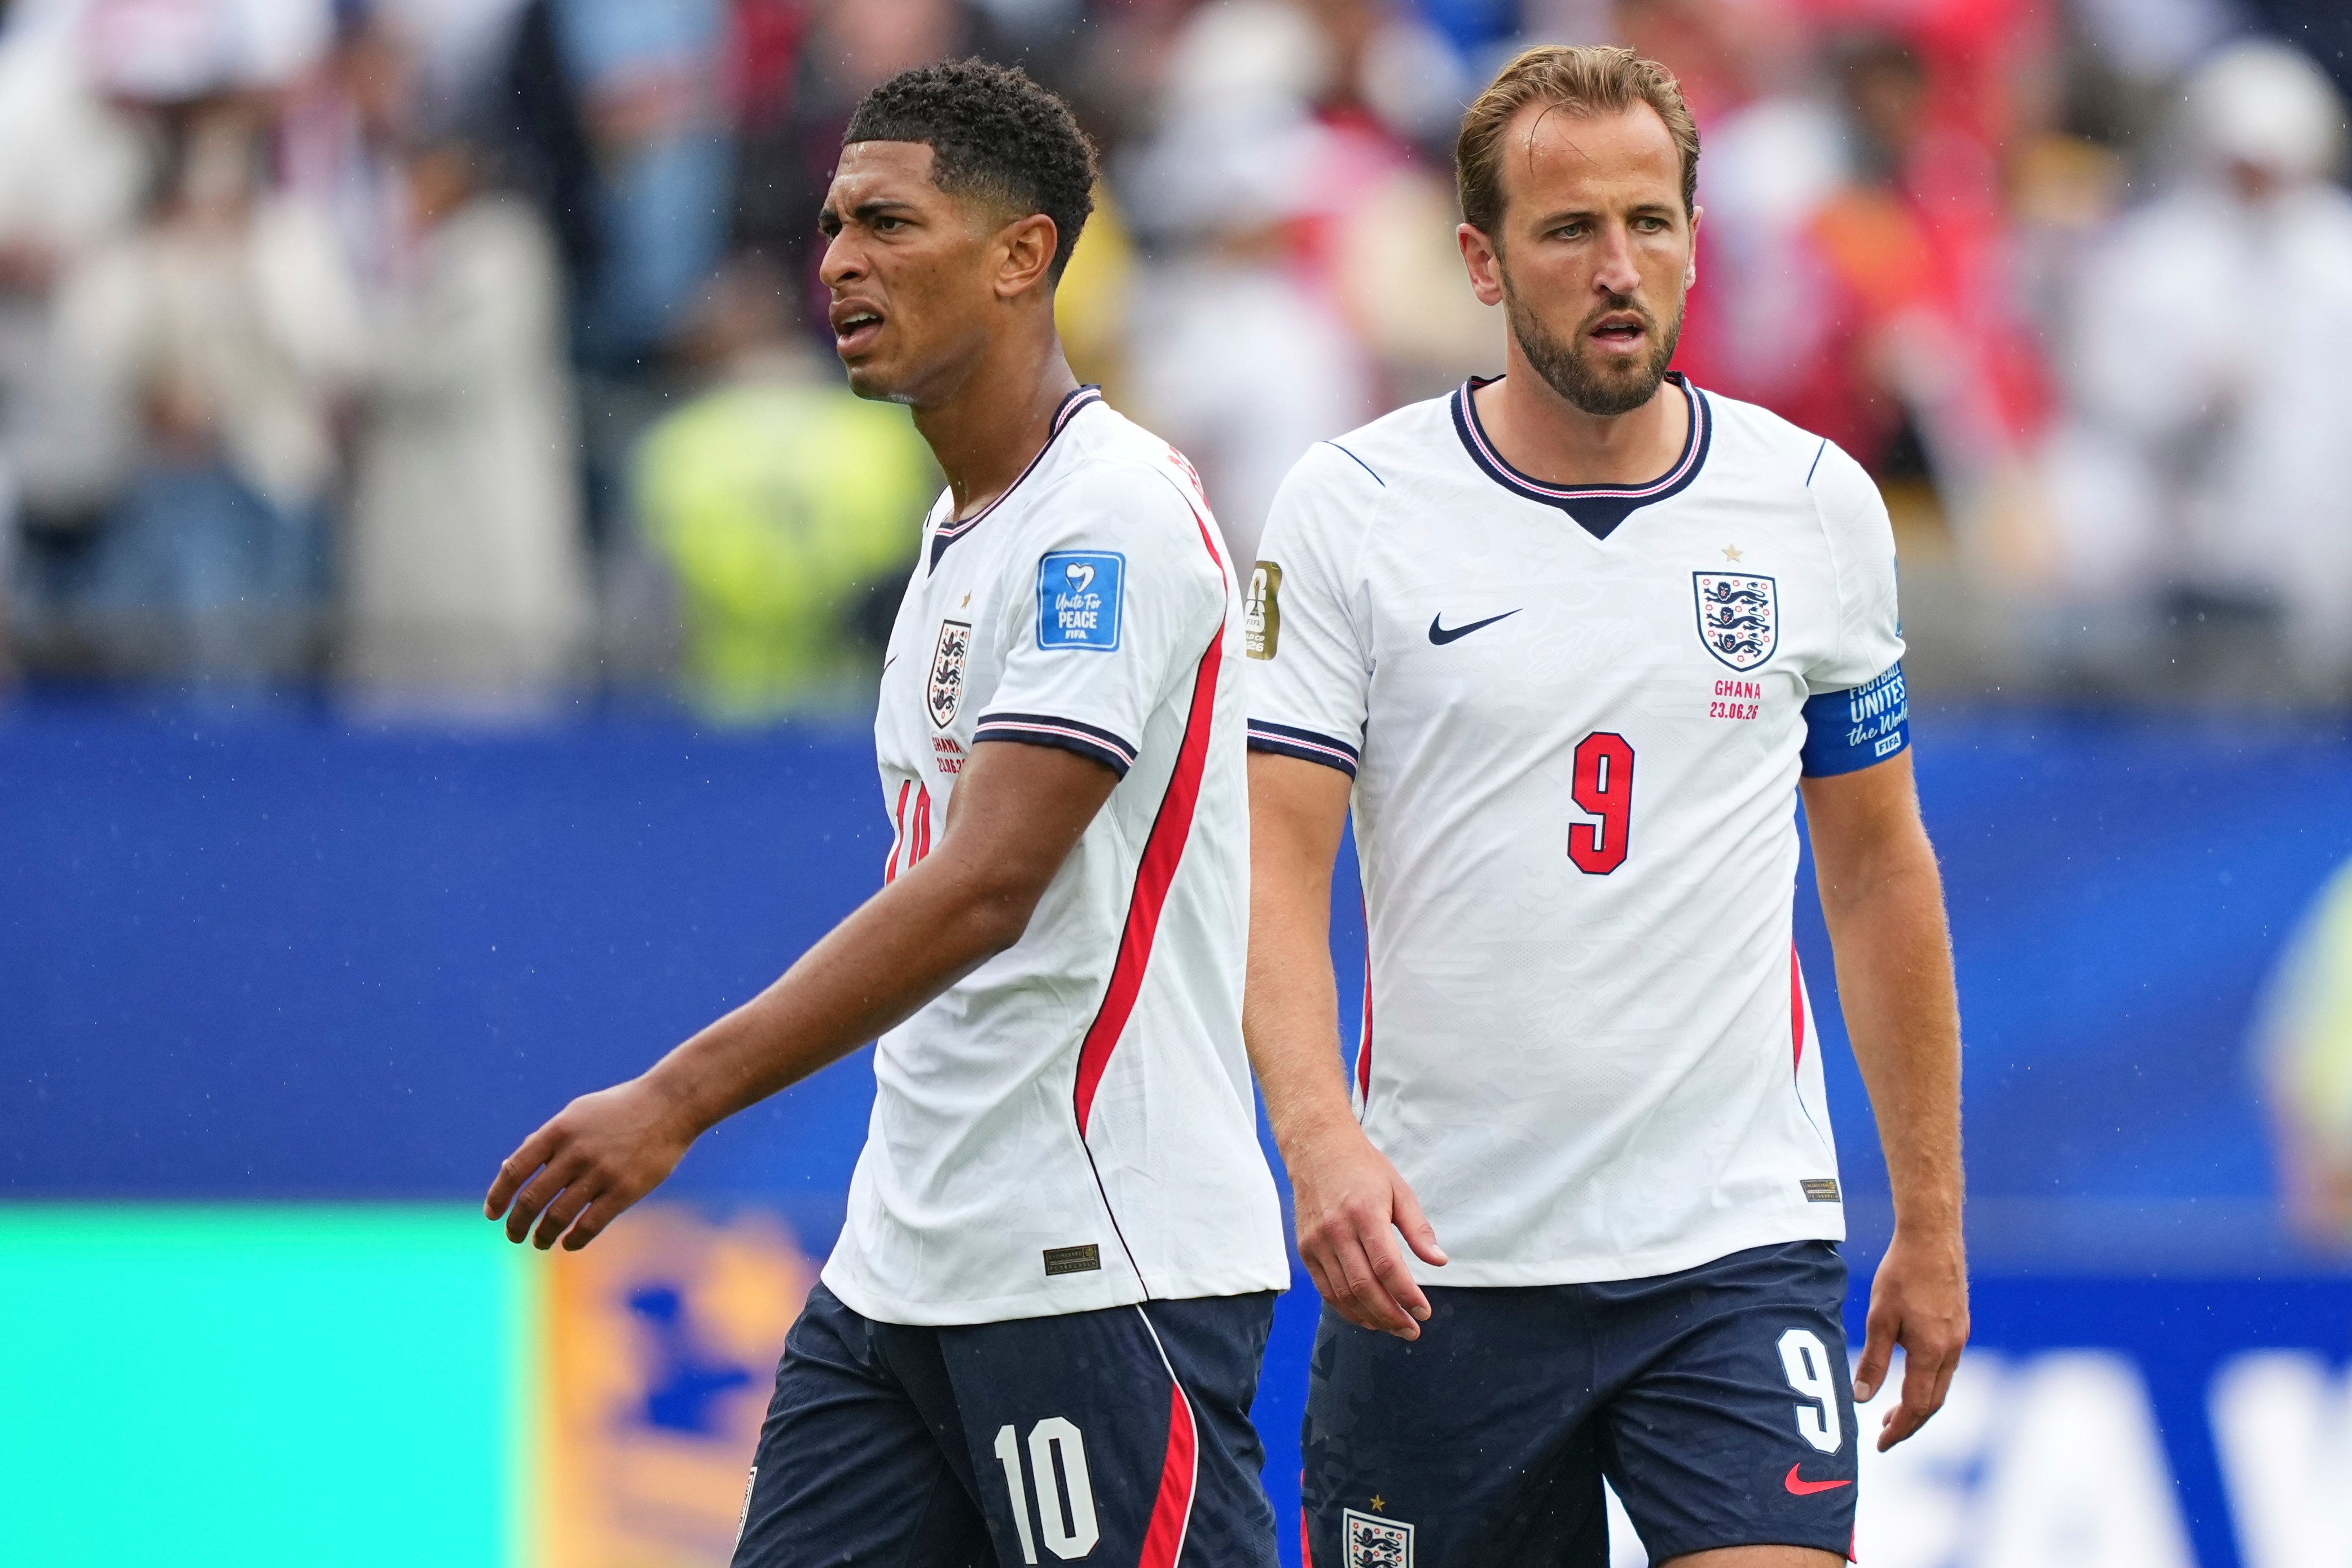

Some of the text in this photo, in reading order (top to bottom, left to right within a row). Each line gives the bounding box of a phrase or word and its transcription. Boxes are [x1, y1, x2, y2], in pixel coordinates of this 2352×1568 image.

[1056, 592, 1102, 611] Unite For
[1058, 611, 1098, 629] PEACE
[1065, 629, 1087, 640] FIFA
[1714, 680, 1761, 699] GHANA
[1850, 676, 1906, 723] UNITES
[1709, 702, 1759, 720] 23.06.26
[1846, 724, 1879, 746] the
[1879, 736, 1900, 753] FIFA
[932, 737, 962, 754] GHANA
[1567, 731, 1635, 875] 9
[1775, 1327, 1843, 1456] 9
[994, 1416, 1100, 1565] 10
